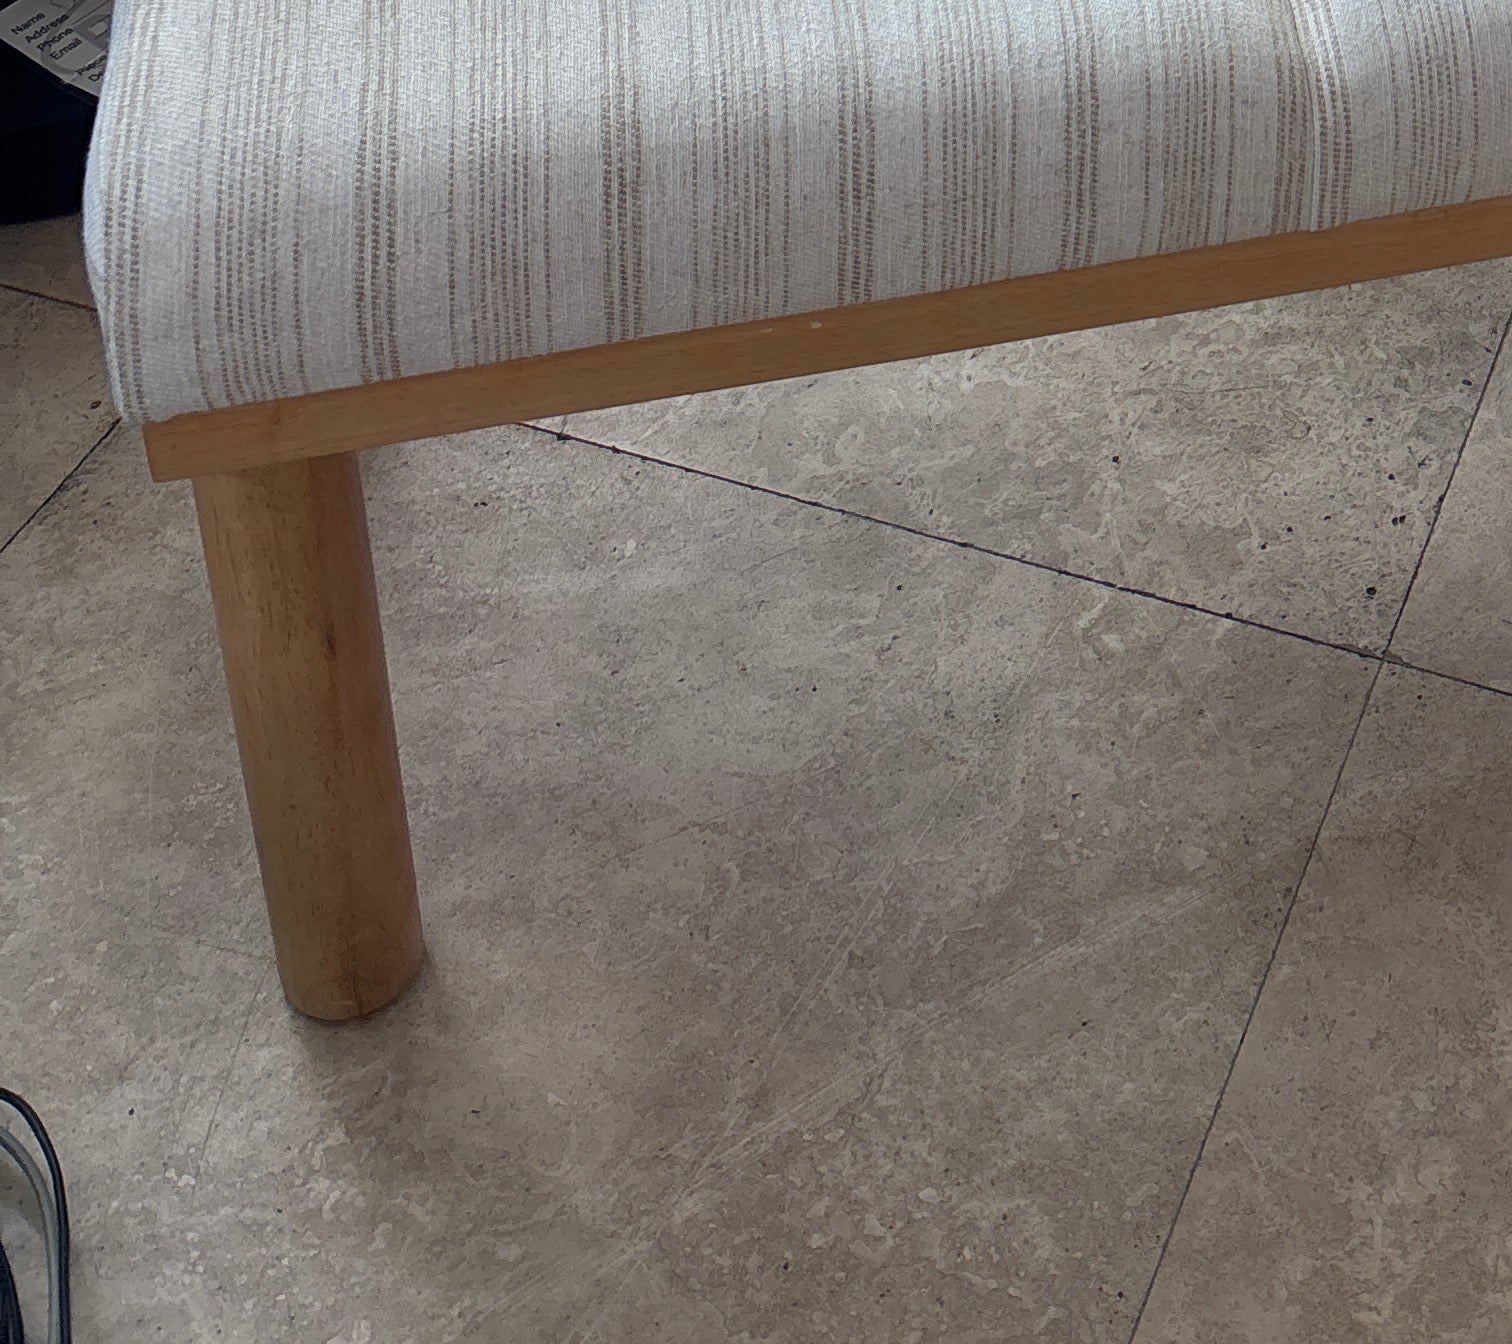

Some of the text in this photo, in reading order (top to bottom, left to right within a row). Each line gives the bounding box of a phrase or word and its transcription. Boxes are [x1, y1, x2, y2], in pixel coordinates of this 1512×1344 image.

[10, 13, 45, 35] Name
[25, 14, 70, 44] Address
[37, 28, 73, 51] Phone
[49, 38, 82, 60] Email
